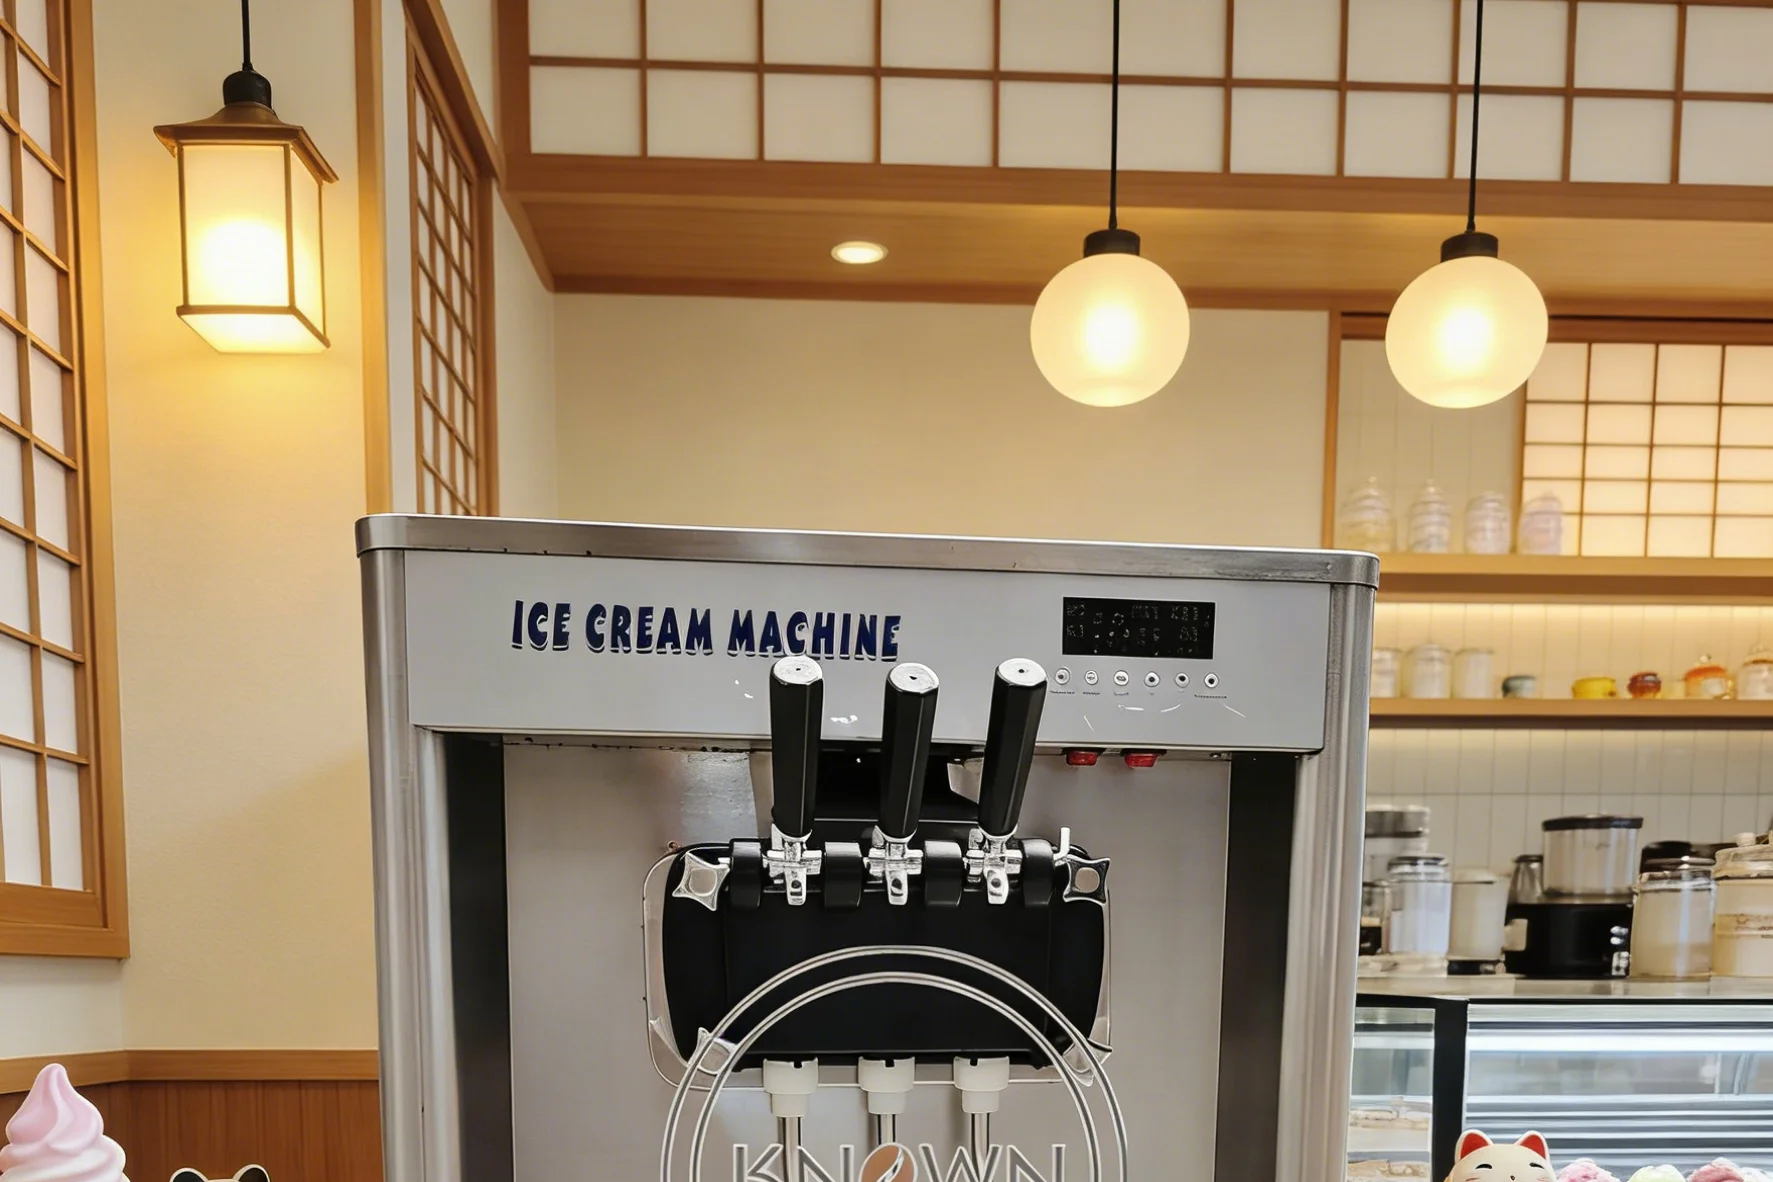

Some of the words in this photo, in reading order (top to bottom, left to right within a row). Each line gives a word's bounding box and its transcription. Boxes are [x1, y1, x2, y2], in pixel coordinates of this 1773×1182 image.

[511, 600, 571, 651] ICE
[585, 603, 714, 656] CREAM
[727, 608, 902, 662] MACHINE
